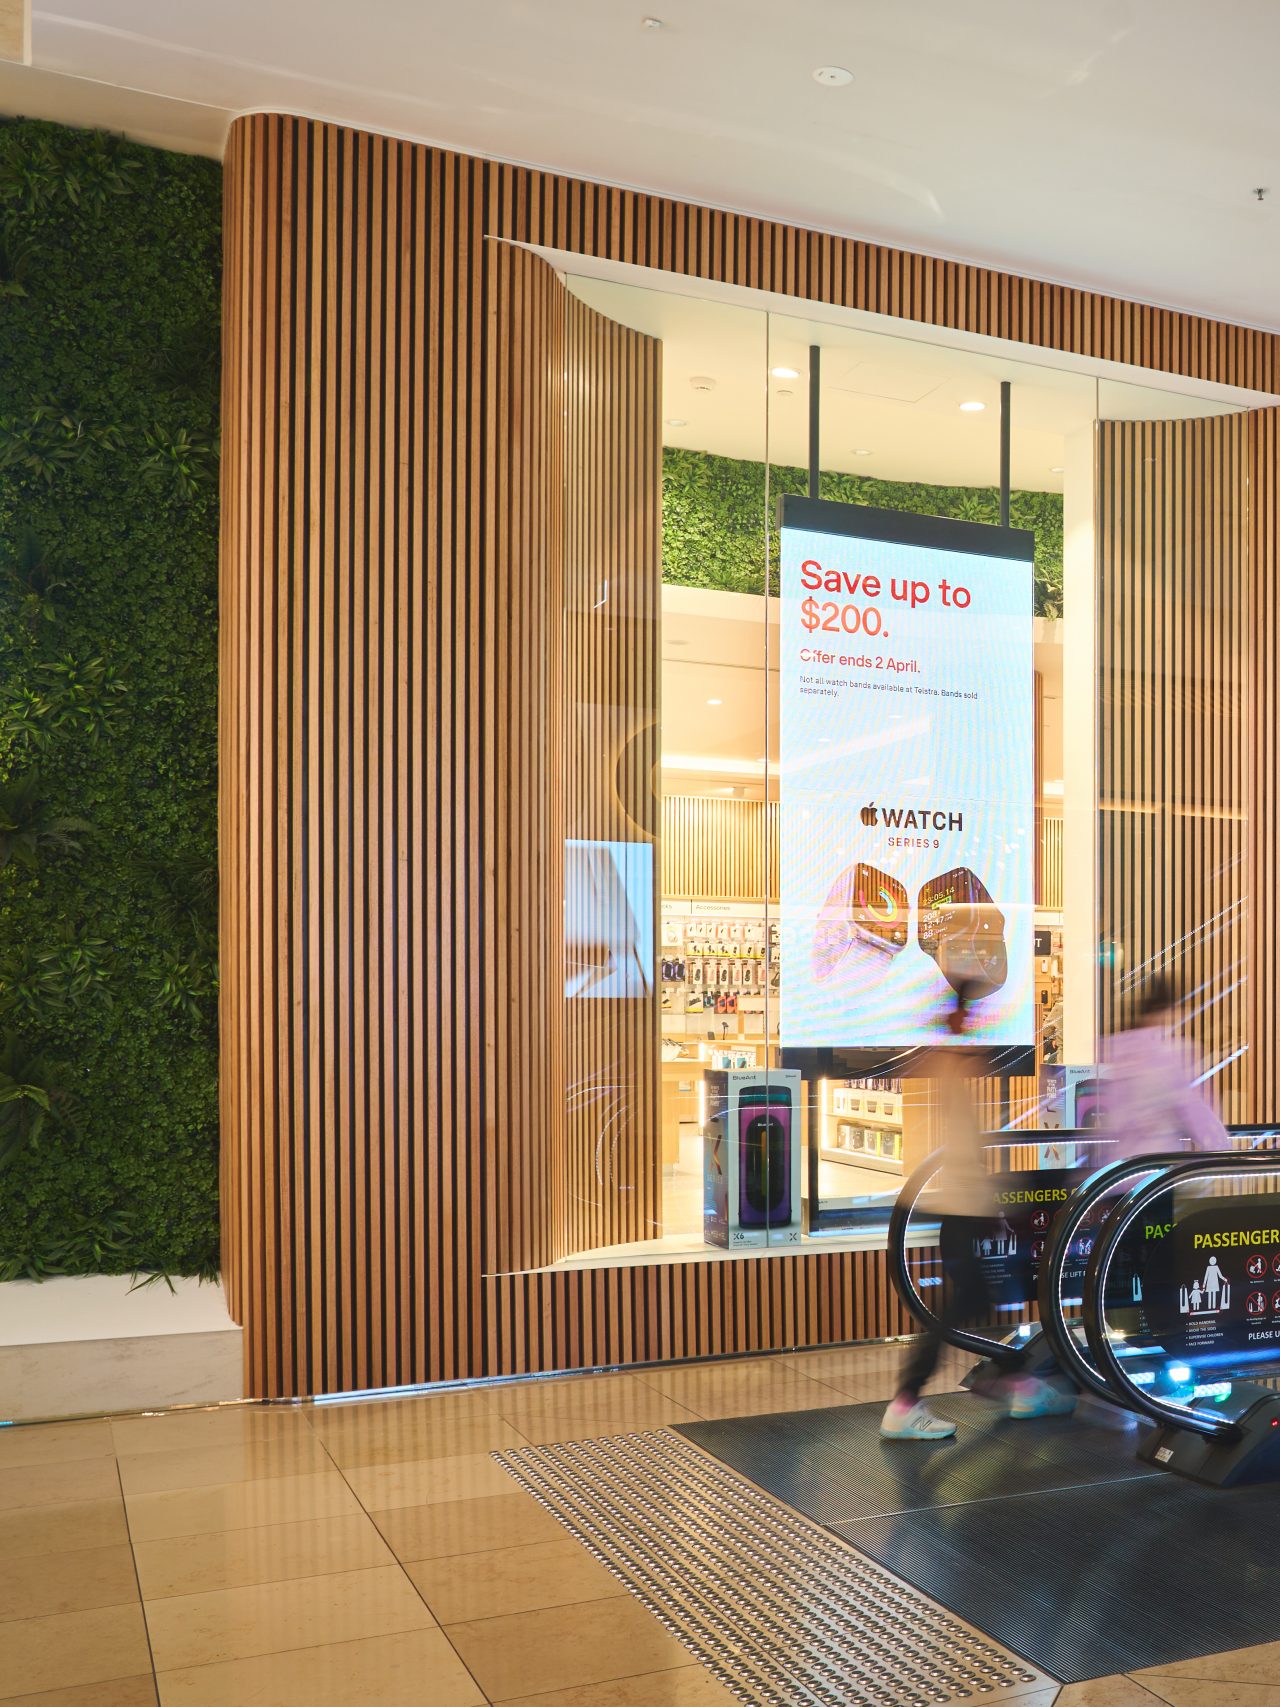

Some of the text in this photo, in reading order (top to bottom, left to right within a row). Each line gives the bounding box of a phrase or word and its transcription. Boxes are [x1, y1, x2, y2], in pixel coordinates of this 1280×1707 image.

[800, 560, 971, 608] Save up to
[800, 596, 888, 637] $200.
[800, 648, 920, 674] Offer ends 2 April.
[800, 676, 813, 684] Not
[815, 677, 824, 685] all
[826, 679, 848, 687] watch
[849, 680, 871, 689] bands
[873, 683, 904, 692] available
[915, 687, 940, 696] Telstra.
[941, 689, 962, 698] Bands
[964, 691, 978, 699] sold
[800, 687, 840, 697] separately.
[882, 808, 962, 832] WATCH
[888, 837, 940, 848] SERIES 9
[992, 1188, 1068, 1204] ASSENGERS
[1248, 1330, 1274, 1340] PLEASE
